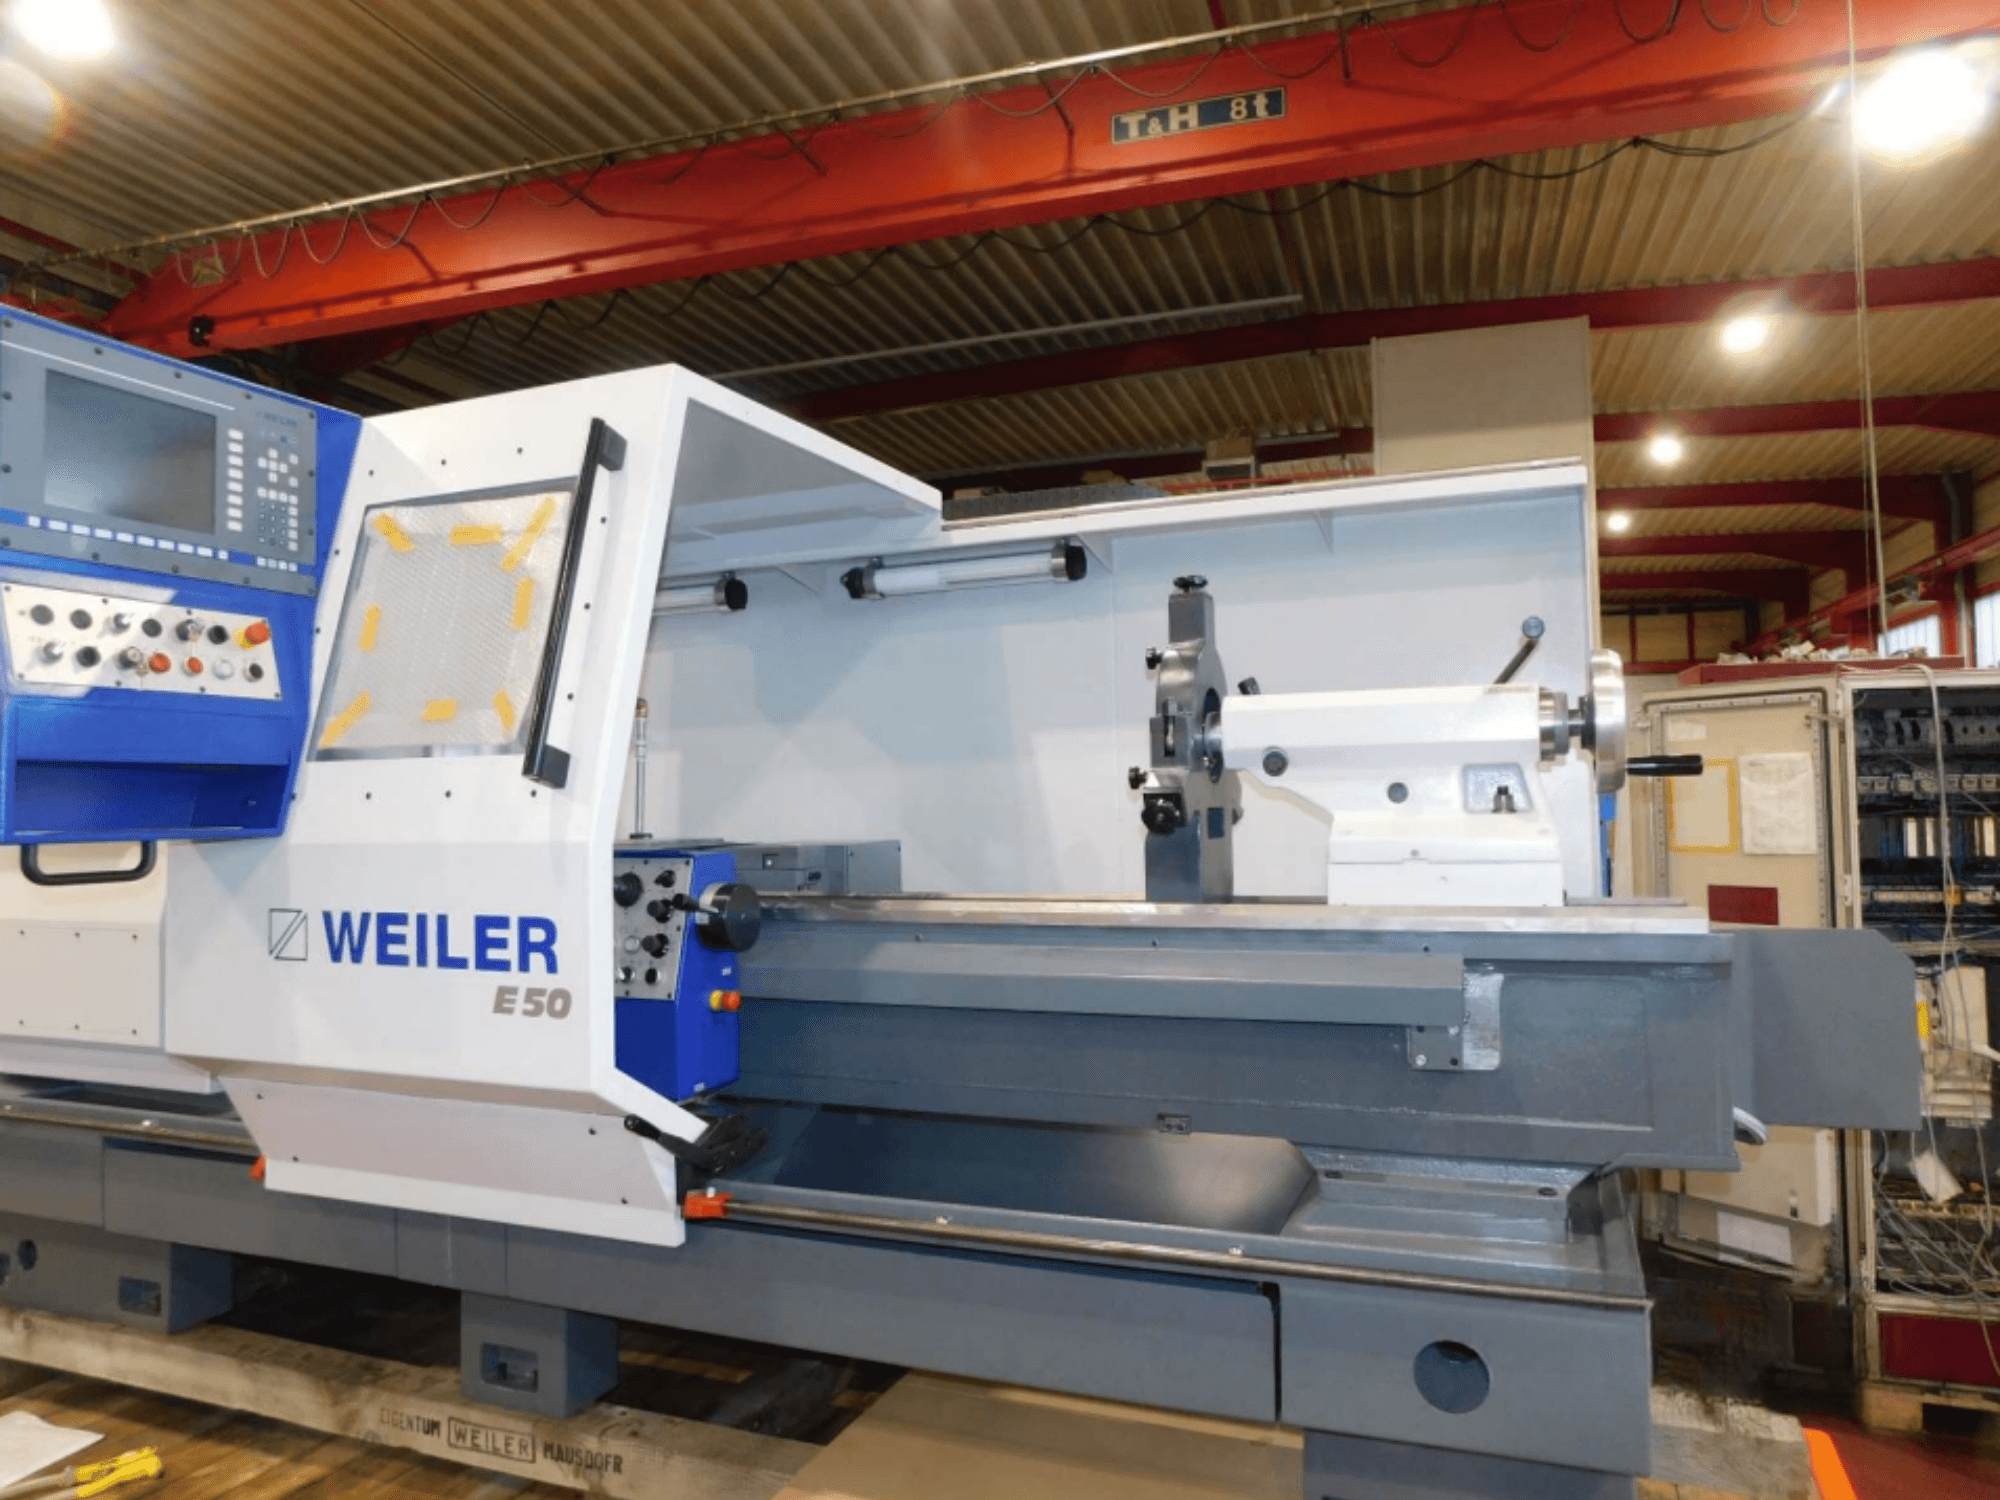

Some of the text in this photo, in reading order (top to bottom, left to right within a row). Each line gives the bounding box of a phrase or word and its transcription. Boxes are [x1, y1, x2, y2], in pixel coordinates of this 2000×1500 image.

[1120, 104, 1199, 138] T&H
[321, 909, 560, 975] WEILER
[379, 1406, 441, 1437] EIGENTUM
[453, 1425, 530, 1457] WEILER
